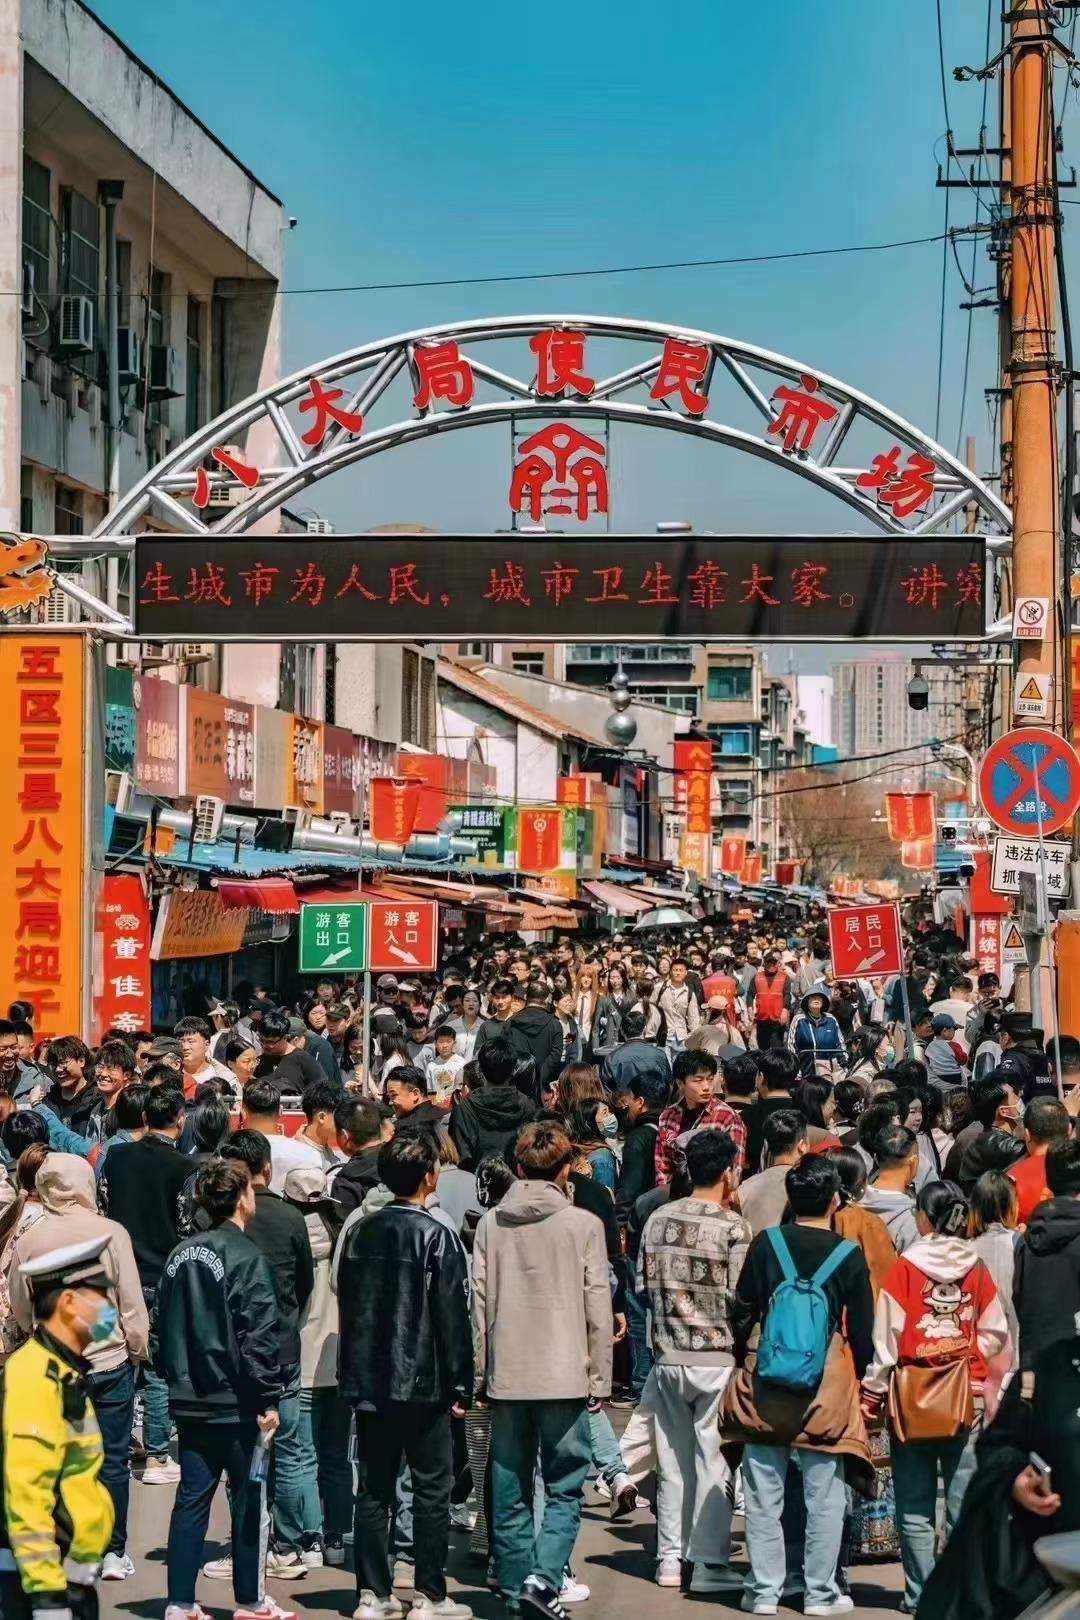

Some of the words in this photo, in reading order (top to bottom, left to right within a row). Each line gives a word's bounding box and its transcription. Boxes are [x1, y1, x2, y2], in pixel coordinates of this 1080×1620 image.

[192, 329, 937, 518] 八大局便民市场
[13, 646, 64, 1042] 五区三县八大局迎千
[1005, 844, 1065, 864] 违法停车
[1002, 868, 1063, 889] 抓域
[316, 912, 351, 928] 游客
[384, 911, 420, 927] 游客
[844, 914, 882, 933] 居民
[316, 931, 350, 946] 出口
[384, 929, 418, 945] 入口
[847, 934, 883, 952] 入口
[978, 917, 998, 974] 传统老
[166, 1246, 225, 1282] CONVERSE
